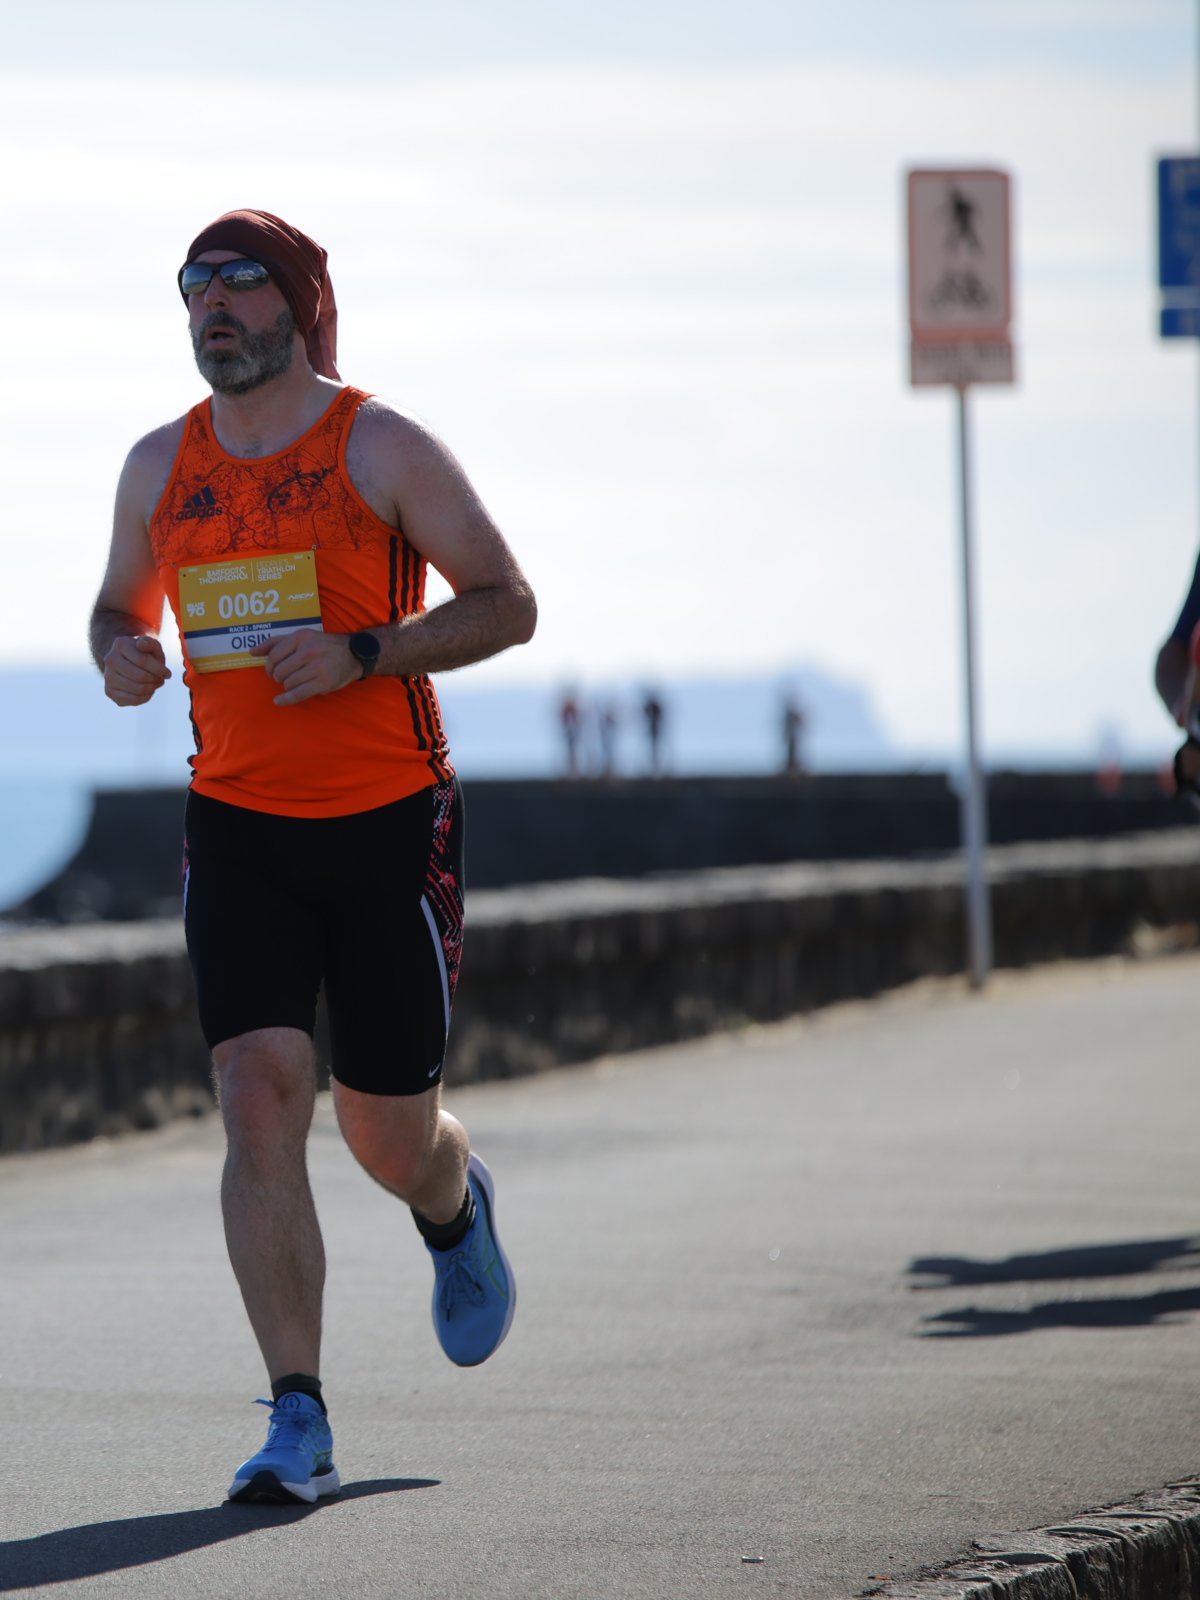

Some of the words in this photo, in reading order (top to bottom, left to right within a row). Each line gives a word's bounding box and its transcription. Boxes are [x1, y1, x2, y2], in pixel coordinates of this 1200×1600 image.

[176, 506, 223, 520] adidas
[257, 564, 296, 574] TRIATHLON
[199, 574, 239, 585] THOMPSON
[258, 573, 283, 582] SERIES
[218, 589, 280, 620] 0062
[252, 622, 272, 630] SPRINT
